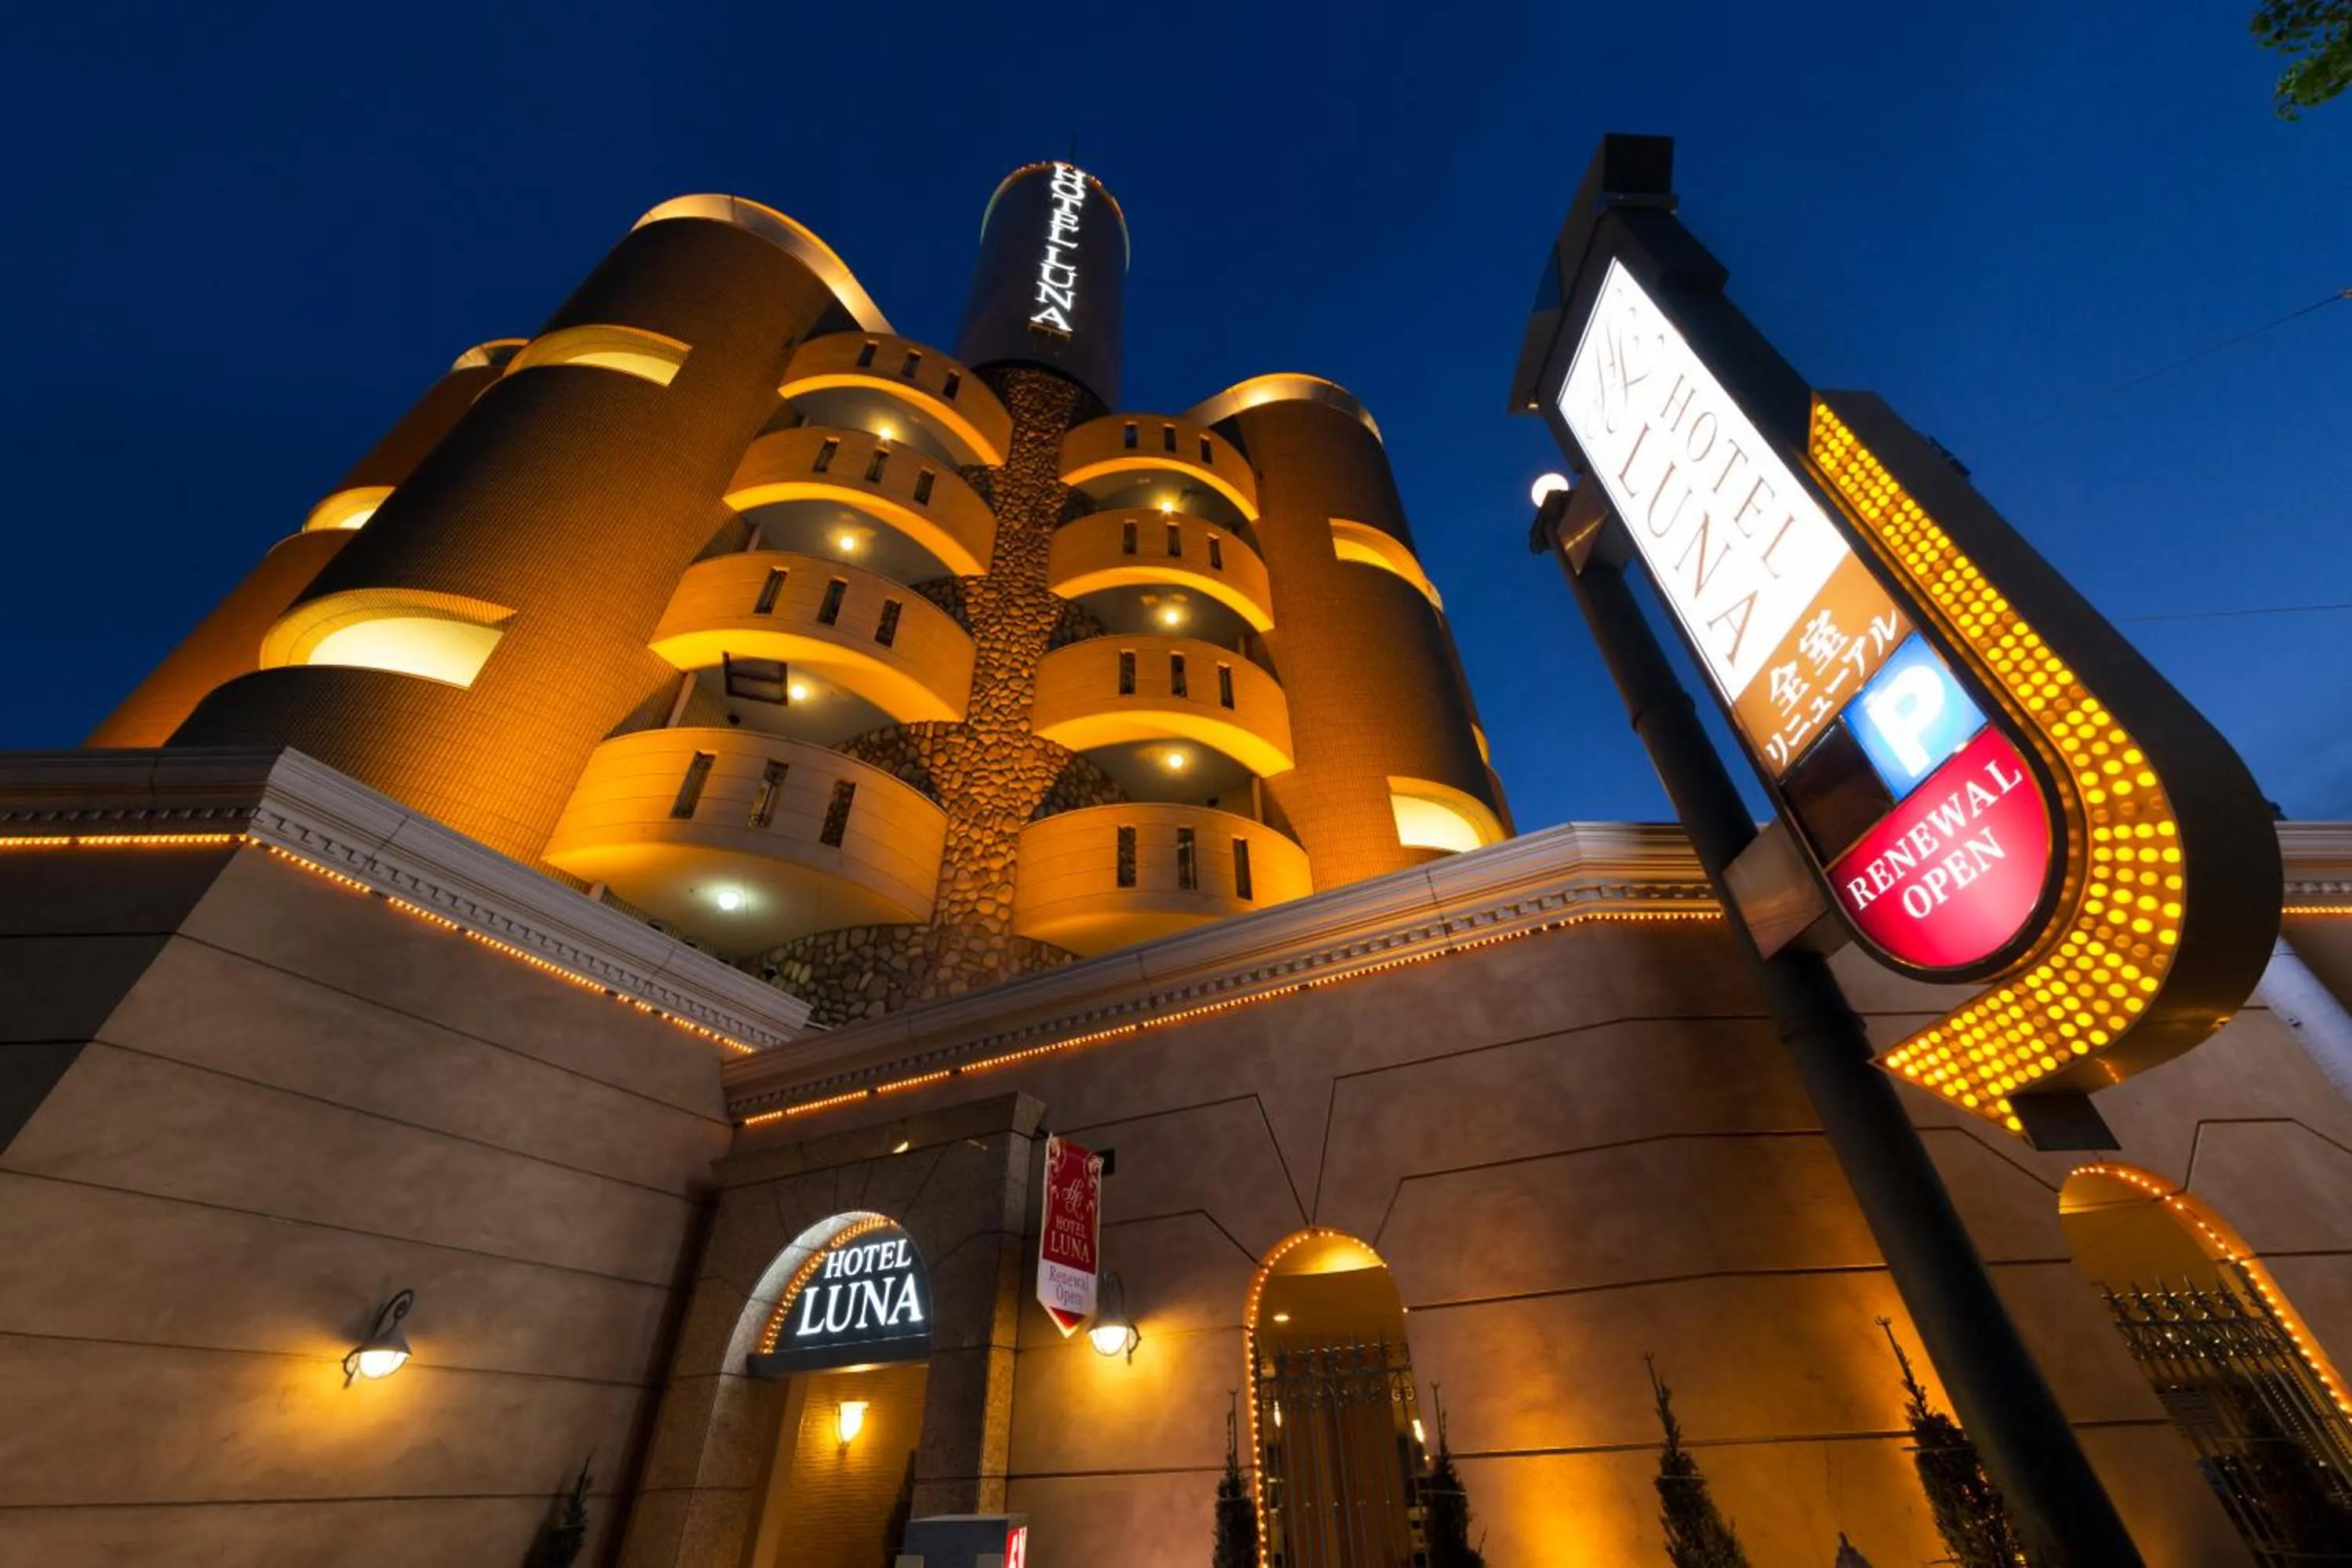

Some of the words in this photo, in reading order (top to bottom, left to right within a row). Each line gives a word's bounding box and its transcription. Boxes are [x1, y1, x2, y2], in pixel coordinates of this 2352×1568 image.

[1048, 162, 1087, 249] HOTEL
[1029, 245, 1078, 332] LUNA
[1660, 373, 1796, 579] HOTEL
[1618, 422, 1759, 669] LUNA
[1766, 609, 1897, 766] リニューアル
[1769, 609, 1849, 717] 全室
[1866, 664, 1945, 779] P
[1846, 759, 2024, 911] RENEWAL
[1901, 826, 2005, 920] OPEN
[824, 1239, 912, 1279] HOTEL
[1051, 1230, 1091, 1263] LUNA
[1055, 1215, 1087, 1239] HOTEL
[796, 1273, 924, 1336] LUNA
[1049, 1265, 1090, 1291] Renewal
[1055, 1284, 1082, 1307] Open
